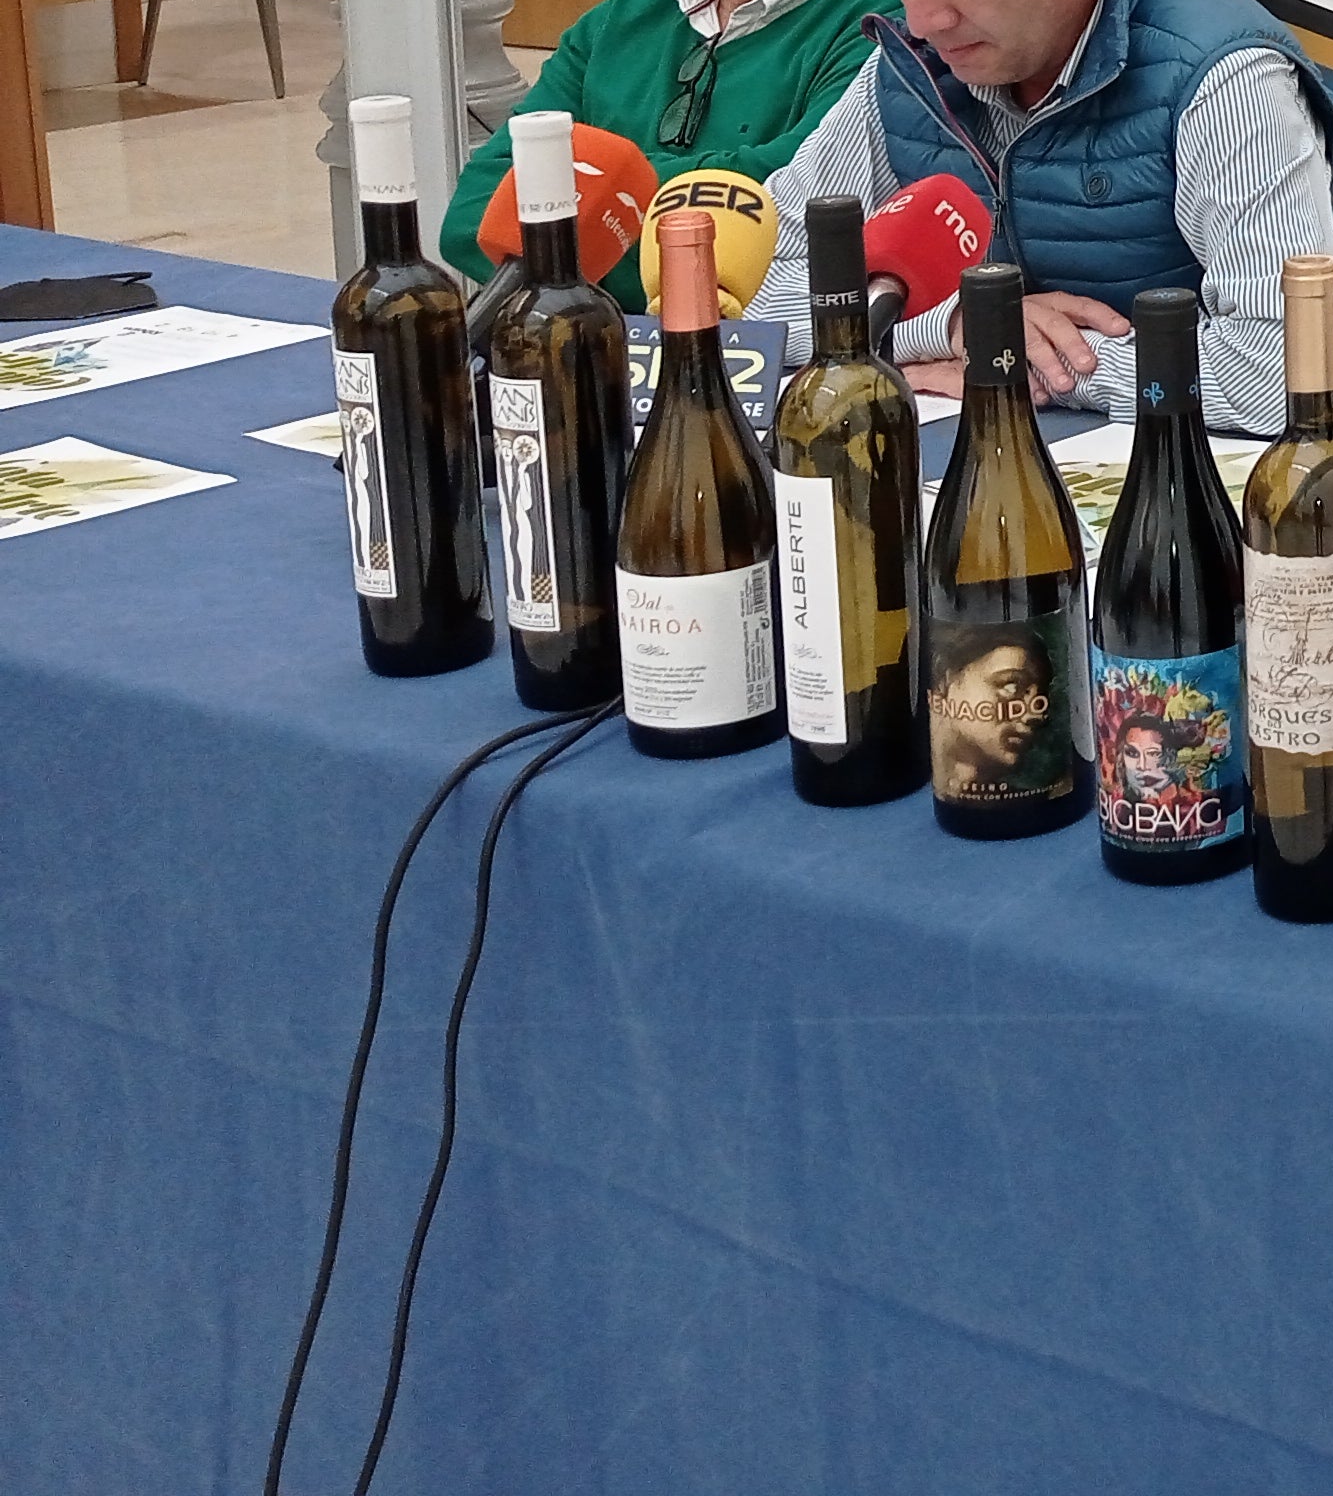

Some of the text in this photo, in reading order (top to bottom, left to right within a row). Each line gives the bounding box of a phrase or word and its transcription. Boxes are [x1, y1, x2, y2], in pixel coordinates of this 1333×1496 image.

[650, 181, 764, 225] SER
[933, 199, 979, 258] rne
[787, 499, 808, 630] ALBERTE
